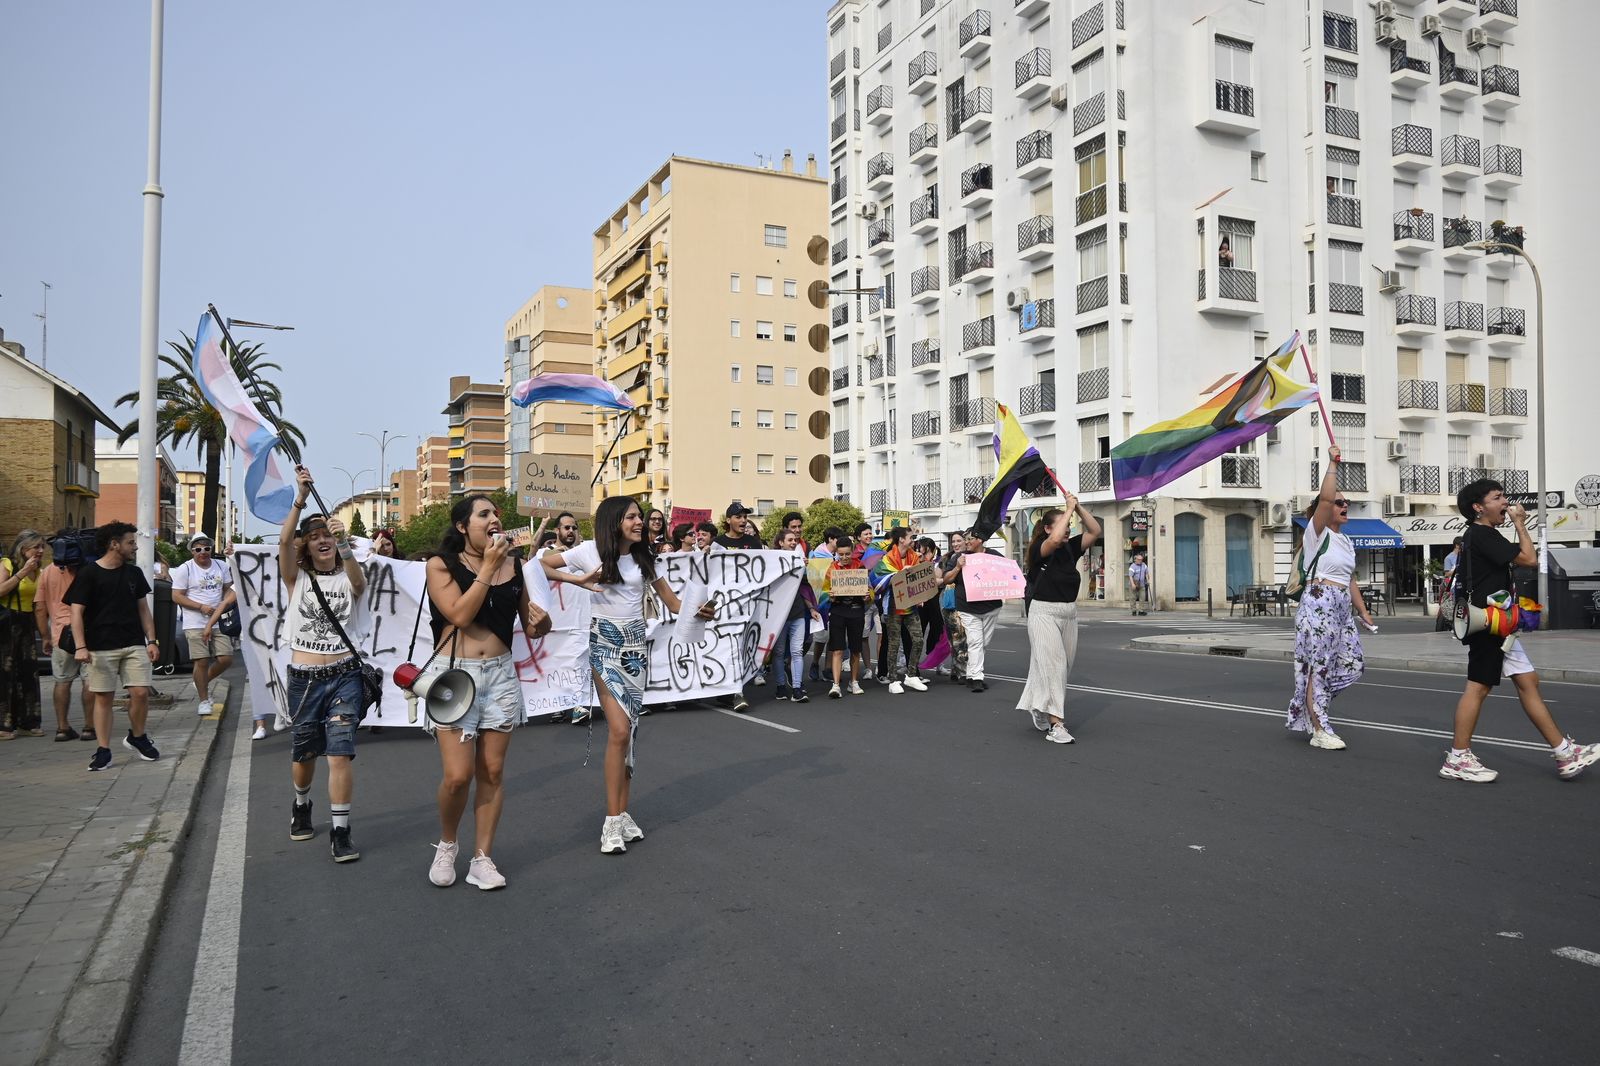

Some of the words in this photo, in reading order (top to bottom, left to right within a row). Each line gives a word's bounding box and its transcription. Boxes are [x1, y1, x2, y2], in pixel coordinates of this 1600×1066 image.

[526, 462, 545, 478] Os
[1406, 518, 1438, 532] Bar
[1364, 538, 1396, 546] CABALLEROS
[657, 552, 766, 586] ENTRO
[779, 556, 806, 579] DE
